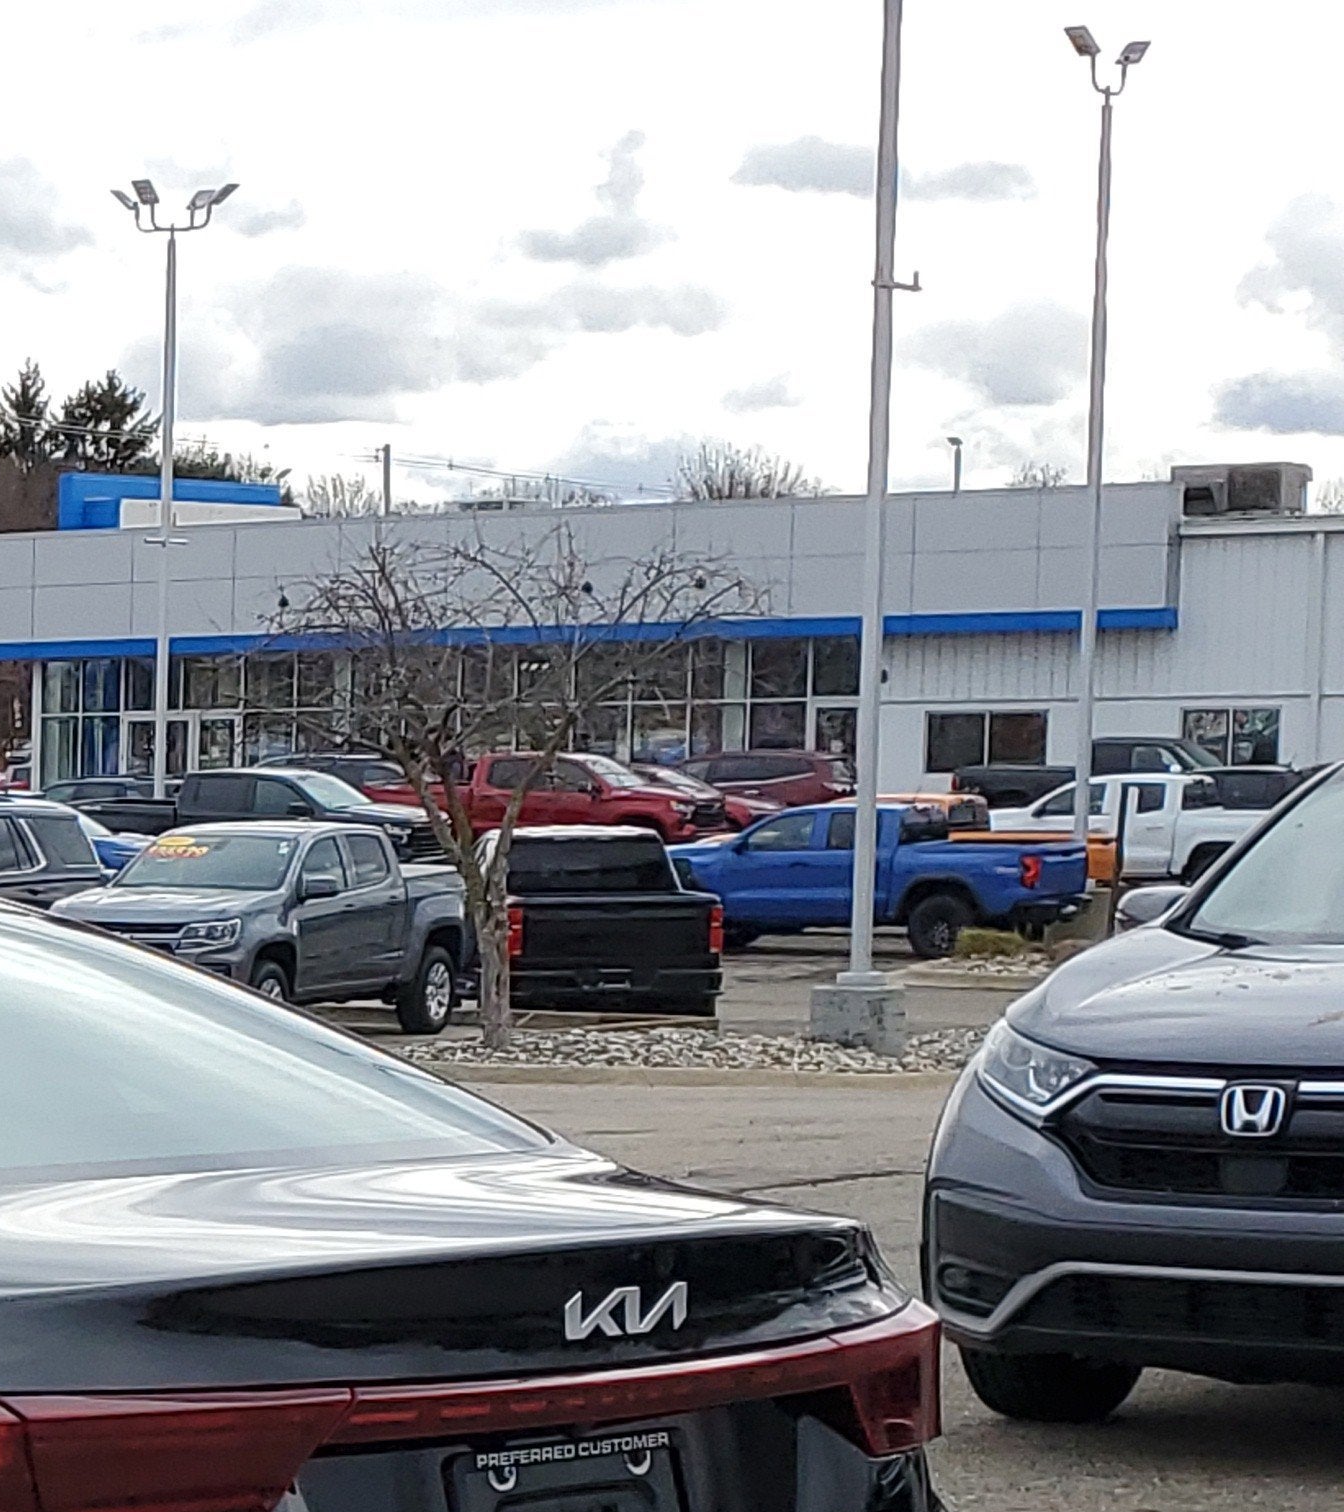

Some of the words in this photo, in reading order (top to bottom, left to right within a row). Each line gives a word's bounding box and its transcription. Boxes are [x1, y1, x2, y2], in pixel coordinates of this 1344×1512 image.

[565, 1281, 688, 1340] KIA
[476, 1444, 575, 1469] PREFERRED
[578, 1432, 669, 1456] CUSTOMER
